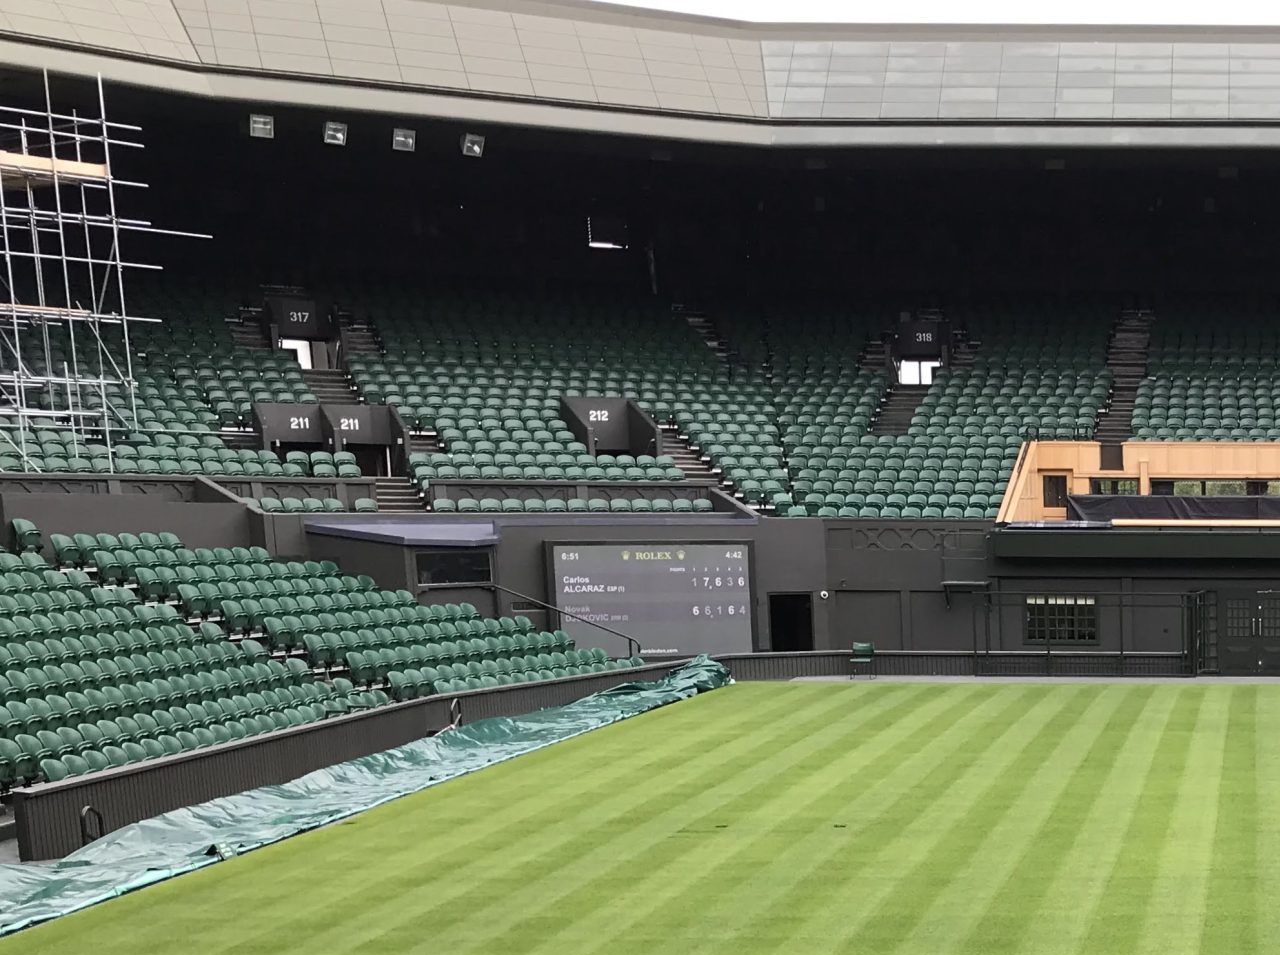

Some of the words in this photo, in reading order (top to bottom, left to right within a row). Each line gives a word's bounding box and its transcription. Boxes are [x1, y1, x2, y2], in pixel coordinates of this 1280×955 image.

[290, 312, 310, 323] 317
[915, 332, 932, 342] 318
[589, 410, 609, 421] 212
[290, 417, 310, 429] 211
[340, 418, 360, 430] 211
[561, 552, 579, 560] 6:51
[635, 551, 672, 560] ROLEX
[725, 551, 742, 559] 4:42
[563, 576, 590, 584] Carlos
[691, 577, 697, 587] 1
[703, 577, 710, 587] 7
[715, 577, 722, 587] 6
[727, 577, 734, 586] 3
[738, 577, 745, 587] 6
[563, 585, 605, 593] ALCARAZ
[565, 605, 591, 613] Novak
[692, 606, 700, 615] 6
[705, 605, 712, 615] 6
[728, 605, 735, 615] 6
